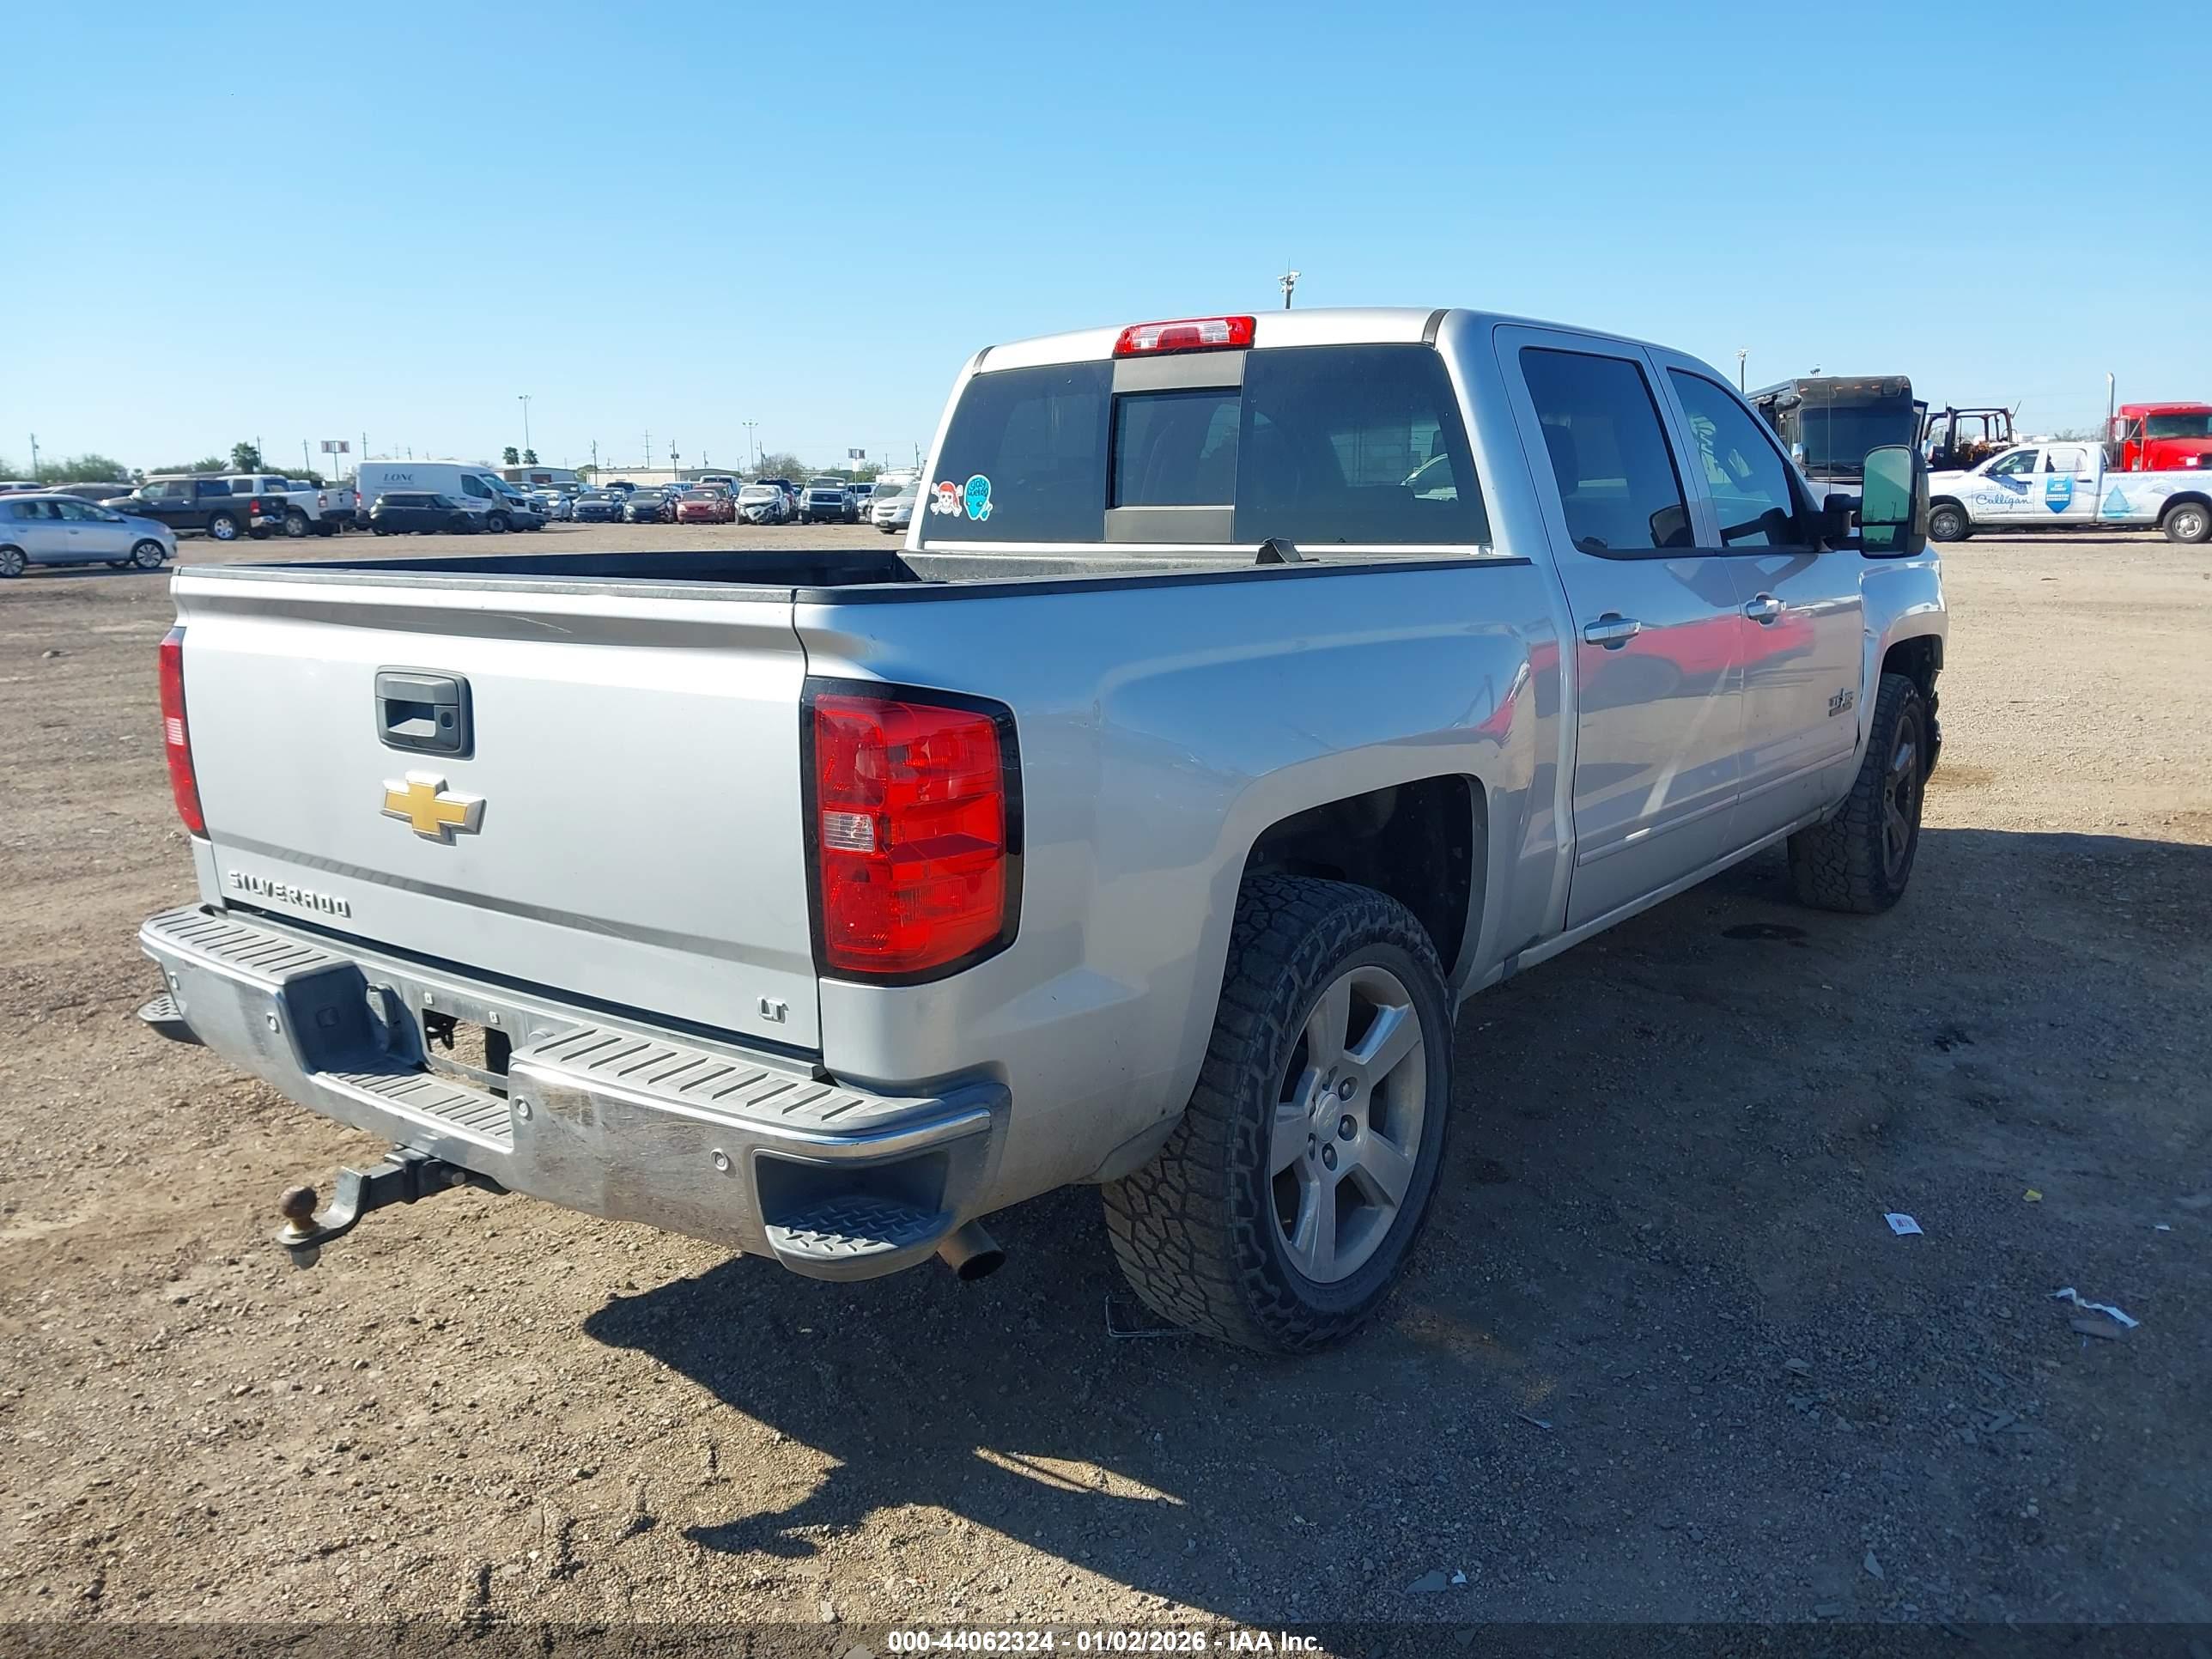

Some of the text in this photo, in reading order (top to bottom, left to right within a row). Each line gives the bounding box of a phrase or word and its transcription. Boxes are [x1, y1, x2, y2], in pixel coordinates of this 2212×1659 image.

[1976, 494, 2032, 509] Culligan
[228, 870, 352, 919] SILVERADO
[757, 996, 789, 1024] LT
